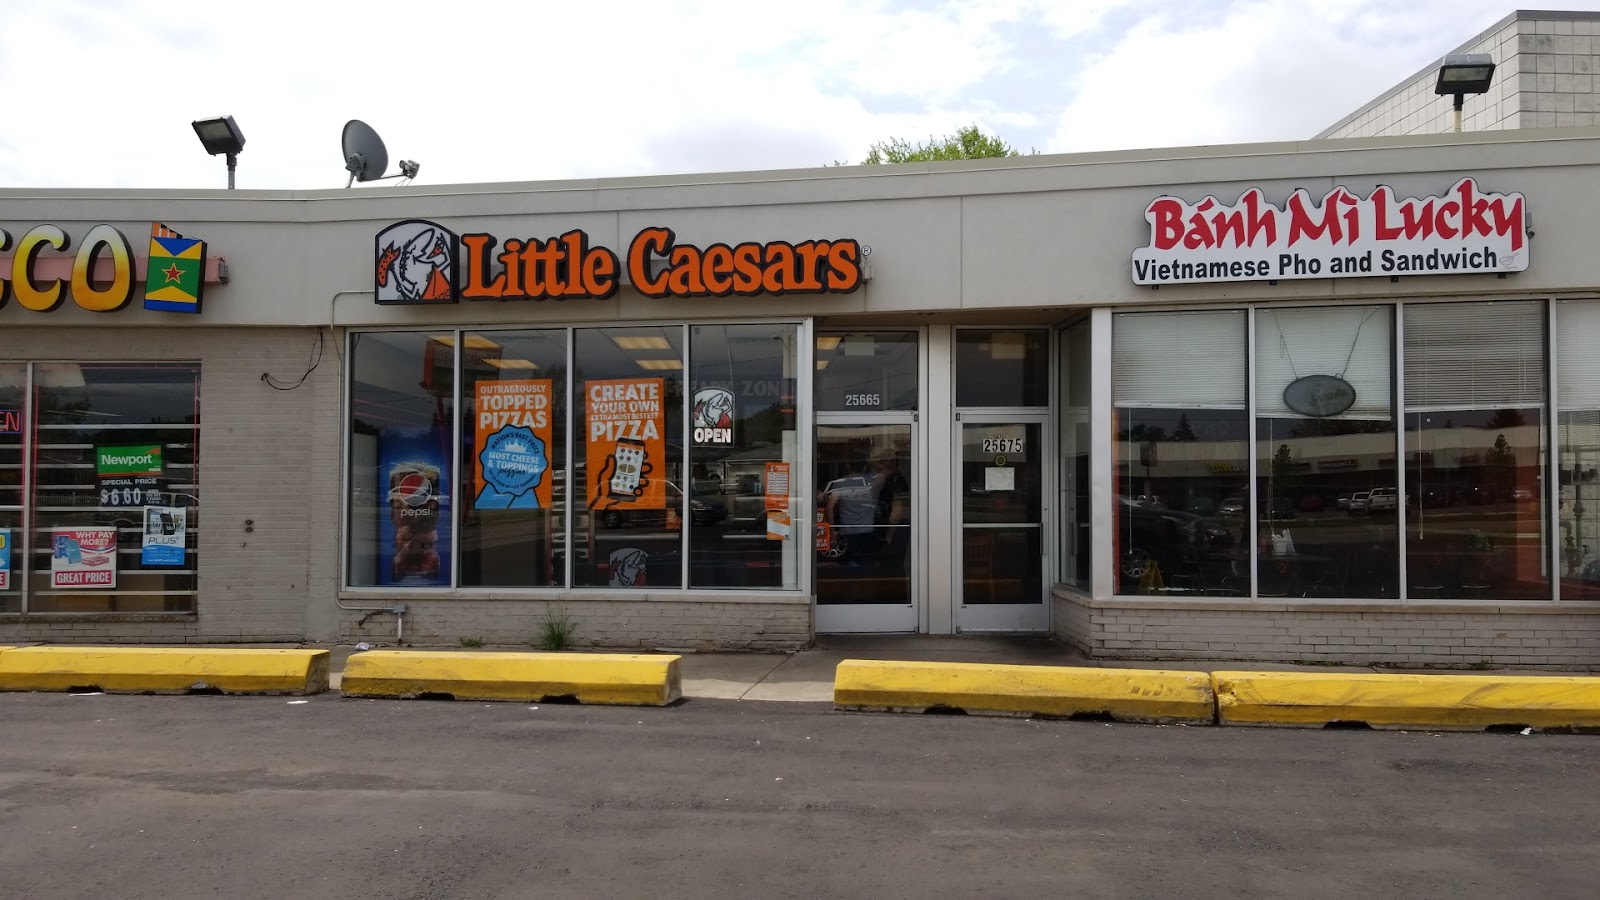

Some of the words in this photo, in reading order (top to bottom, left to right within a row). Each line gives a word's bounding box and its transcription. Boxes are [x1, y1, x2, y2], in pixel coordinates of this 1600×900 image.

[1148, 189, 1277, 250] Bánh
[1287, 187, 1360, 248] Mì
[1371, 179, 1523, 252] Lucky
[0, 223, 136, 312] CO
[461, 229, 619, 299] Little
[628, 227, 862, 298] Caesars
[1134, 258, 1270, 281] Vietnamese
[1279, 253, 1321, 276] Pho
[1330, 250, 1372, 274] and
[1381, 246, 1497, 272] Sandwich
[481, 384, 547, 394] OUTRAGEOUSLY
[590, 383, 659, 402] CREATE
[481, 394, 548, 411] TOPPED
[591, 401, 627, 414] YOUR
[629, 400, 659, 413] OWN
[845, 394, 880, 406] 25665
[480, 411, 548, 429] PIZZAS
[591, 419, 659, 442] PIZZA
[694, 428, 732, 443] OPEN
[984, 438, 1022, 452] 25675
[101, 453, 152, 467] Newport
[488, 451, 511, 461] MOST
[511, 454, 540, 464] CHEESE
[487, 459, 494, 468] &
[496, 460, 539, 473] TOPPINGS
[400, 507, 431, 518] pepsi
[76, 531, 97, 539] WHY
[98, 531, 114, 539] PAY
[80, 538, 109, 546] MORE?
[57, 572, 83, 584] GREAT
[85, 571, 110, 583] PRICE
